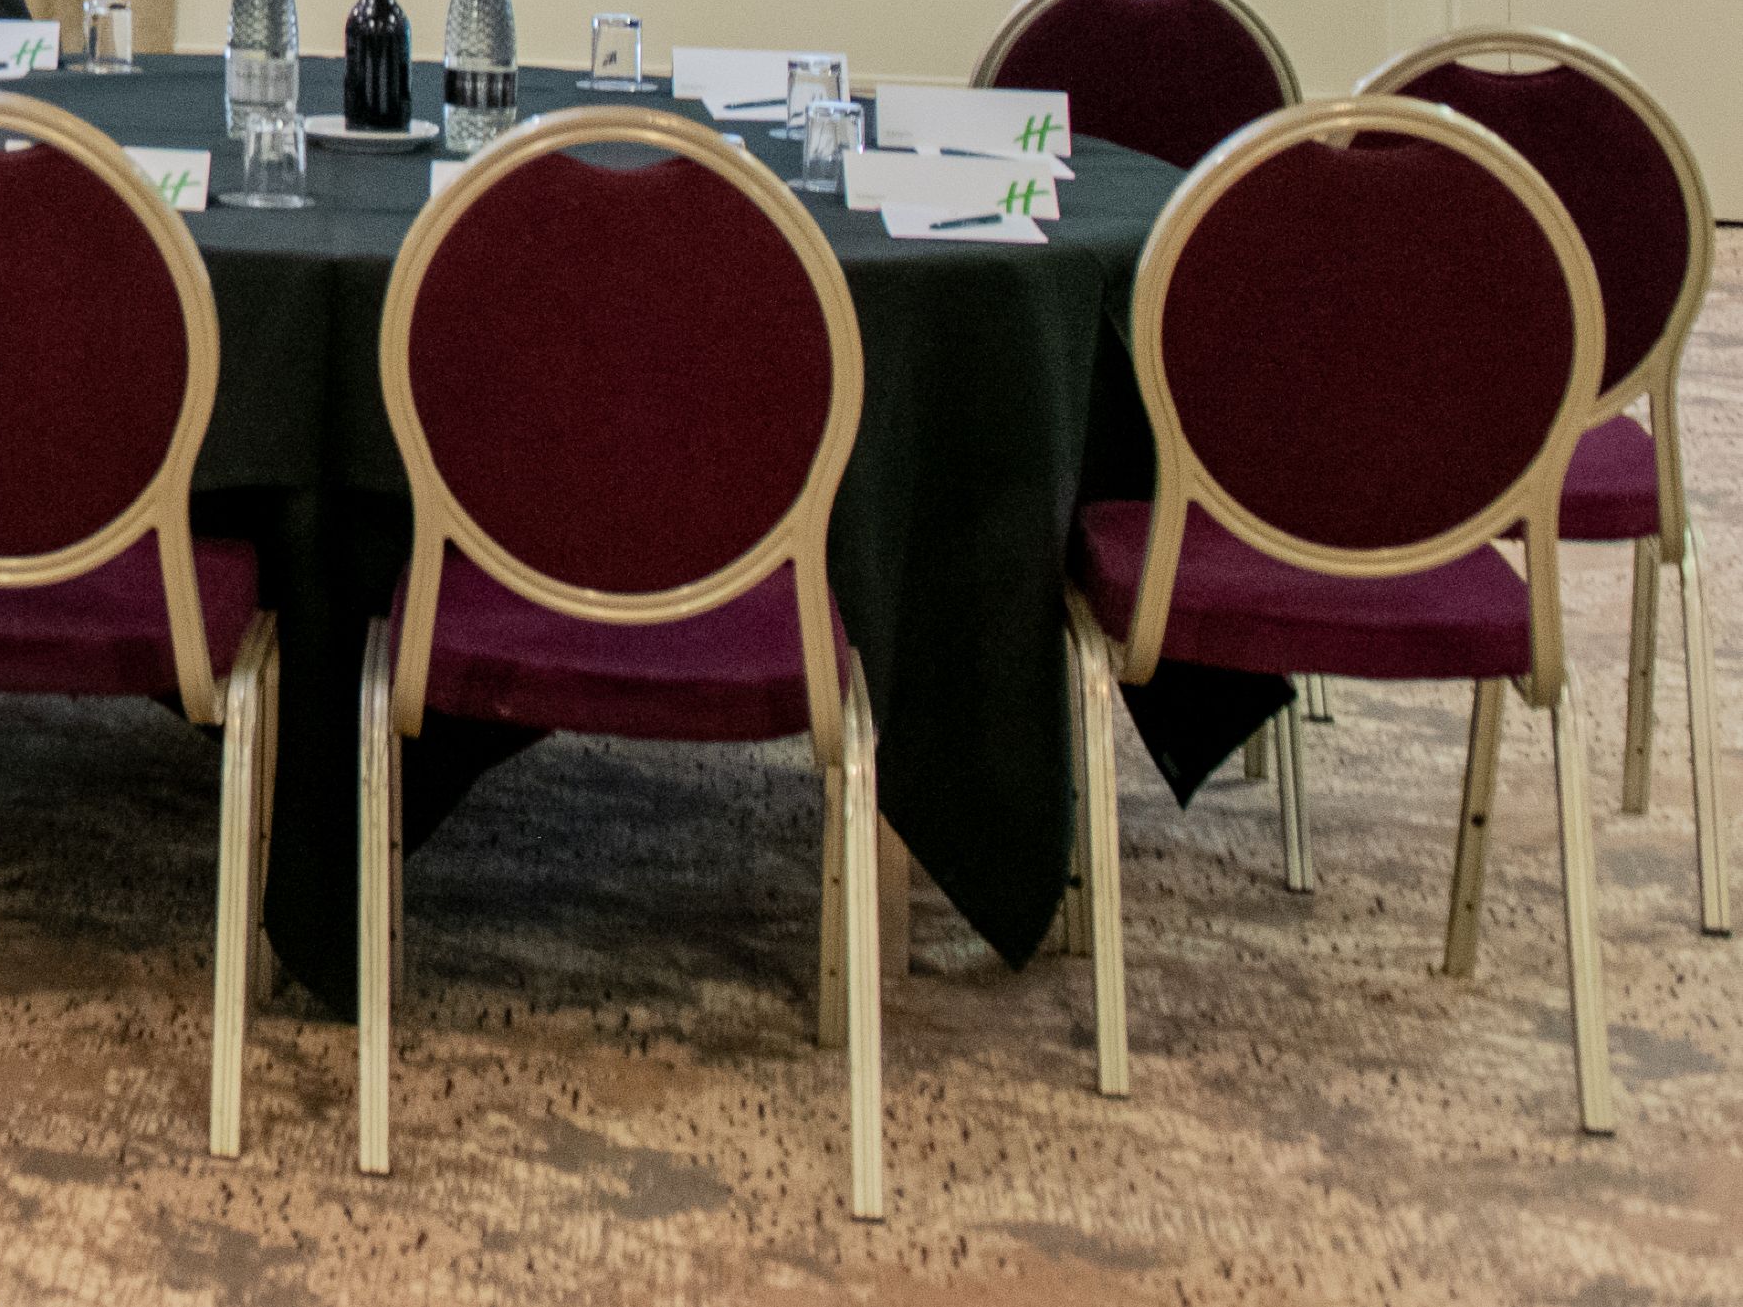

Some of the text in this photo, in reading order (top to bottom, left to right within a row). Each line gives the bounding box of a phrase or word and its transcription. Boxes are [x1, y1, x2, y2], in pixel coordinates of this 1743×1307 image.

[12, 39, 52, 69] H
[1014, 113, 1064, 152] H
[997, 179, 1050, 215] H
